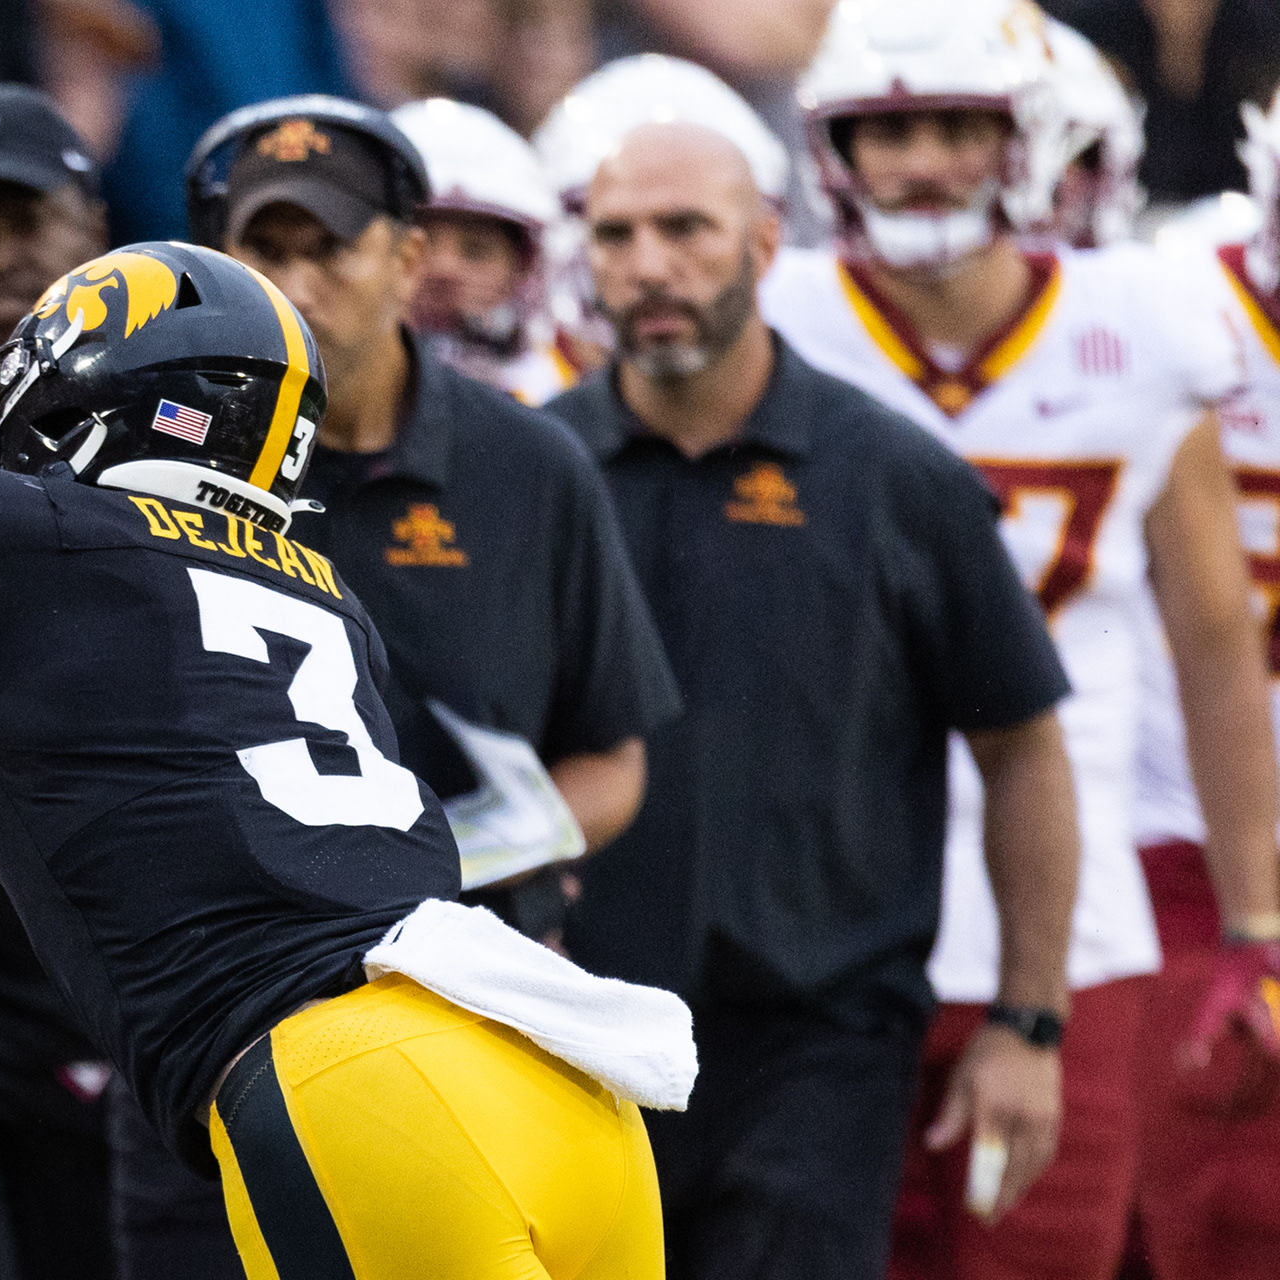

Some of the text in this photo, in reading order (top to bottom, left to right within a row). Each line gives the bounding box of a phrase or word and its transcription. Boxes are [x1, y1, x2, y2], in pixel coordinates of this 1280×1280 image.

[281, 415, 316, 481] 3
[128, 495, 343, 600] DEJEAN
[186, 567, 425, 832] 3
